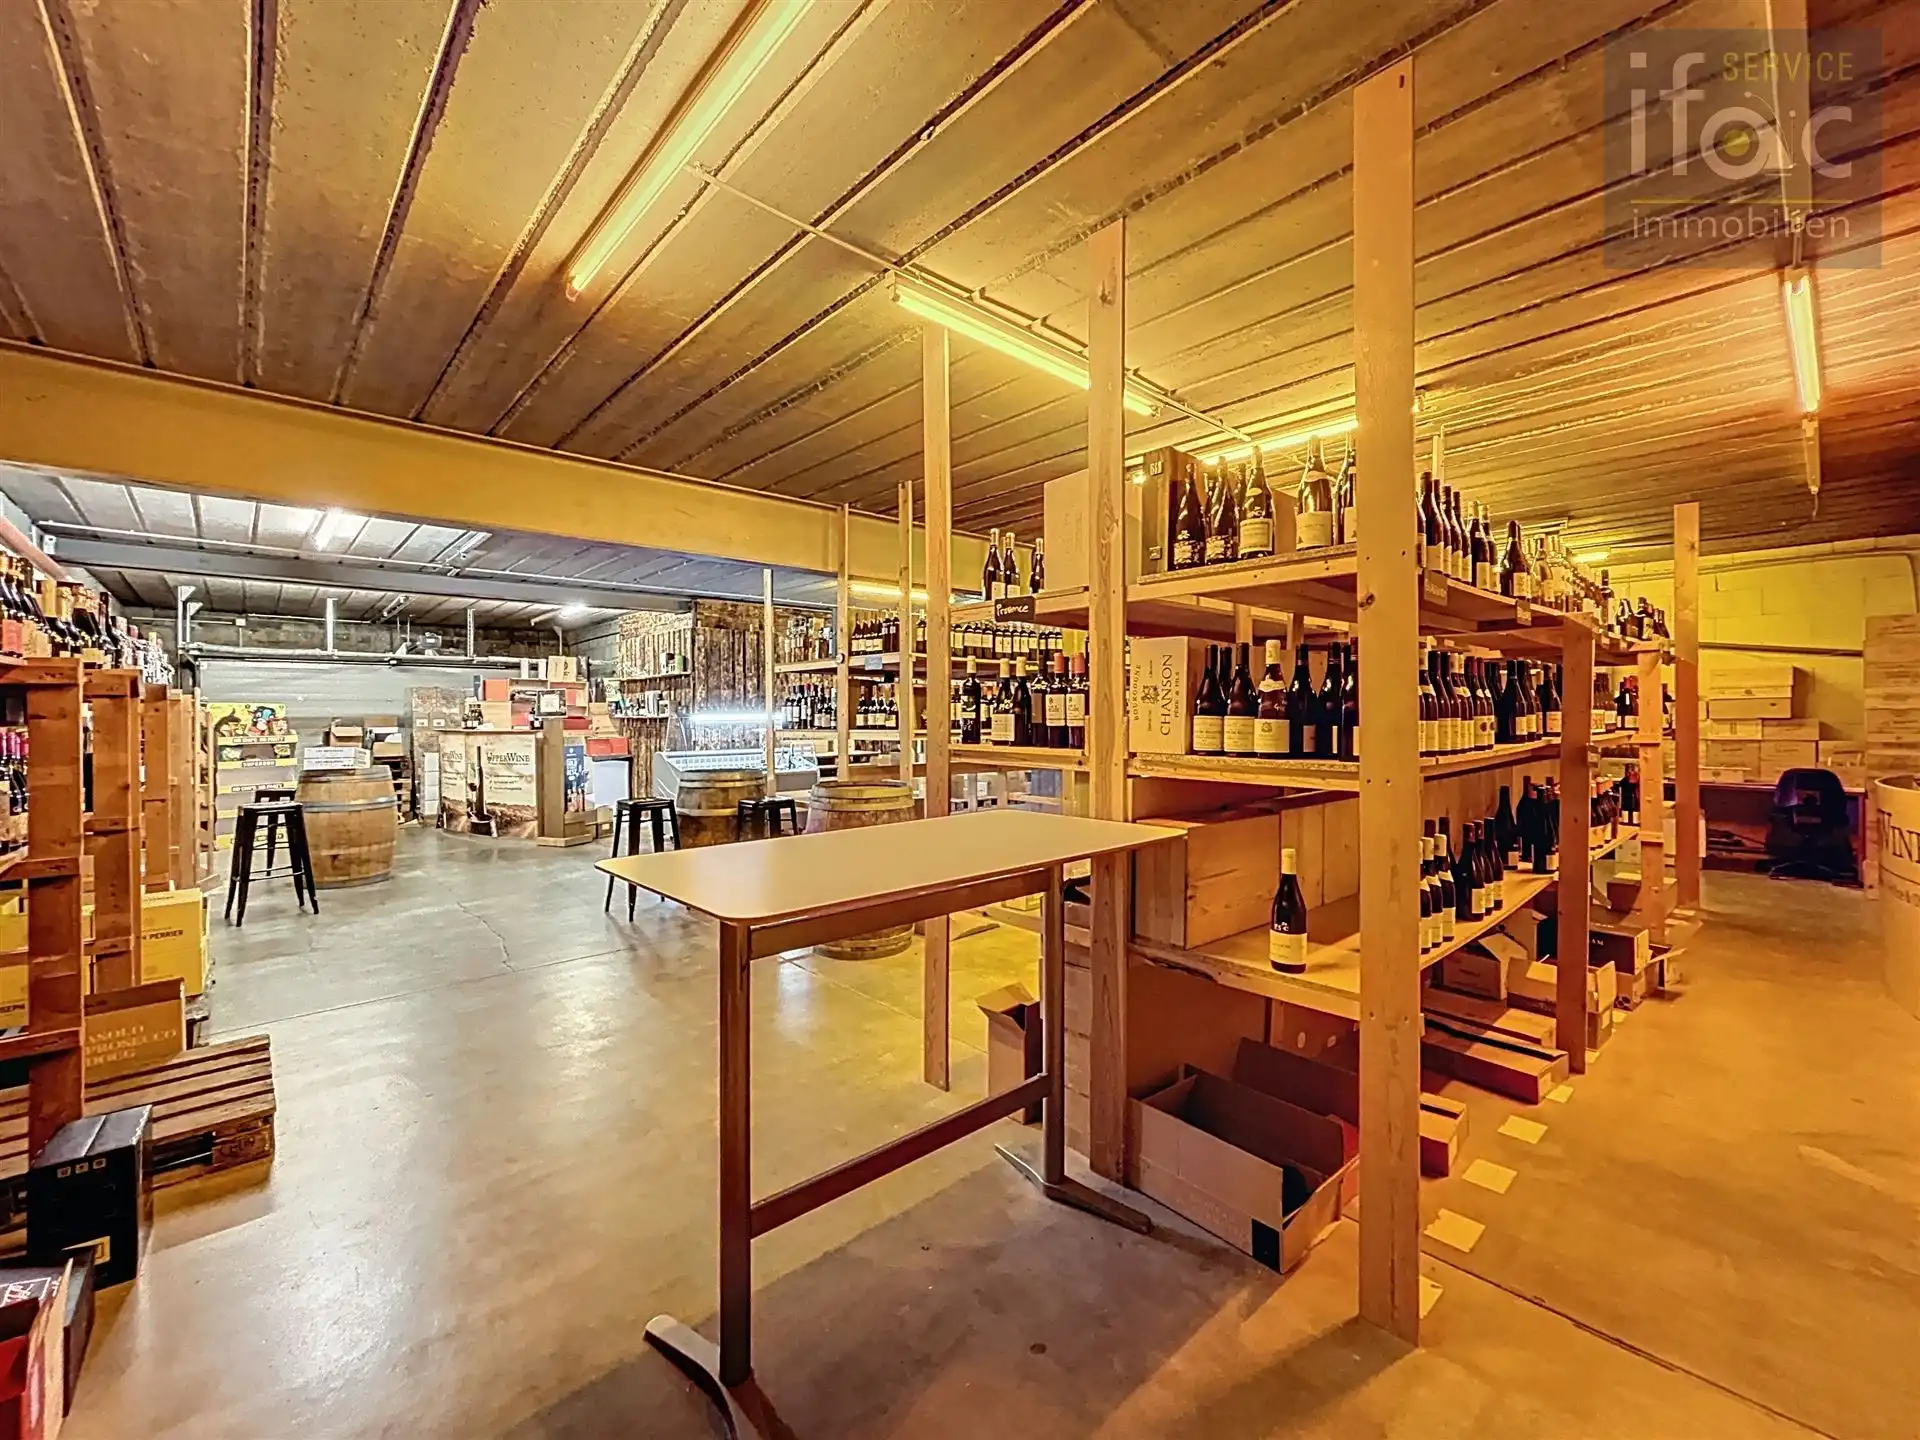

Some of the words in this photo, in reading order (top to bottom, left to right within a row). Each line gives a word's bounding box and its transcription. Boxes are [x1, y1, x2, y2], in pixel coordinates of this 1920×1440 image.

[1160, 654, 1173, 736] CHANSON
[149, 929, 184, 941] PERRIER
[85, 1029, 177, 1056] PROSECCO
